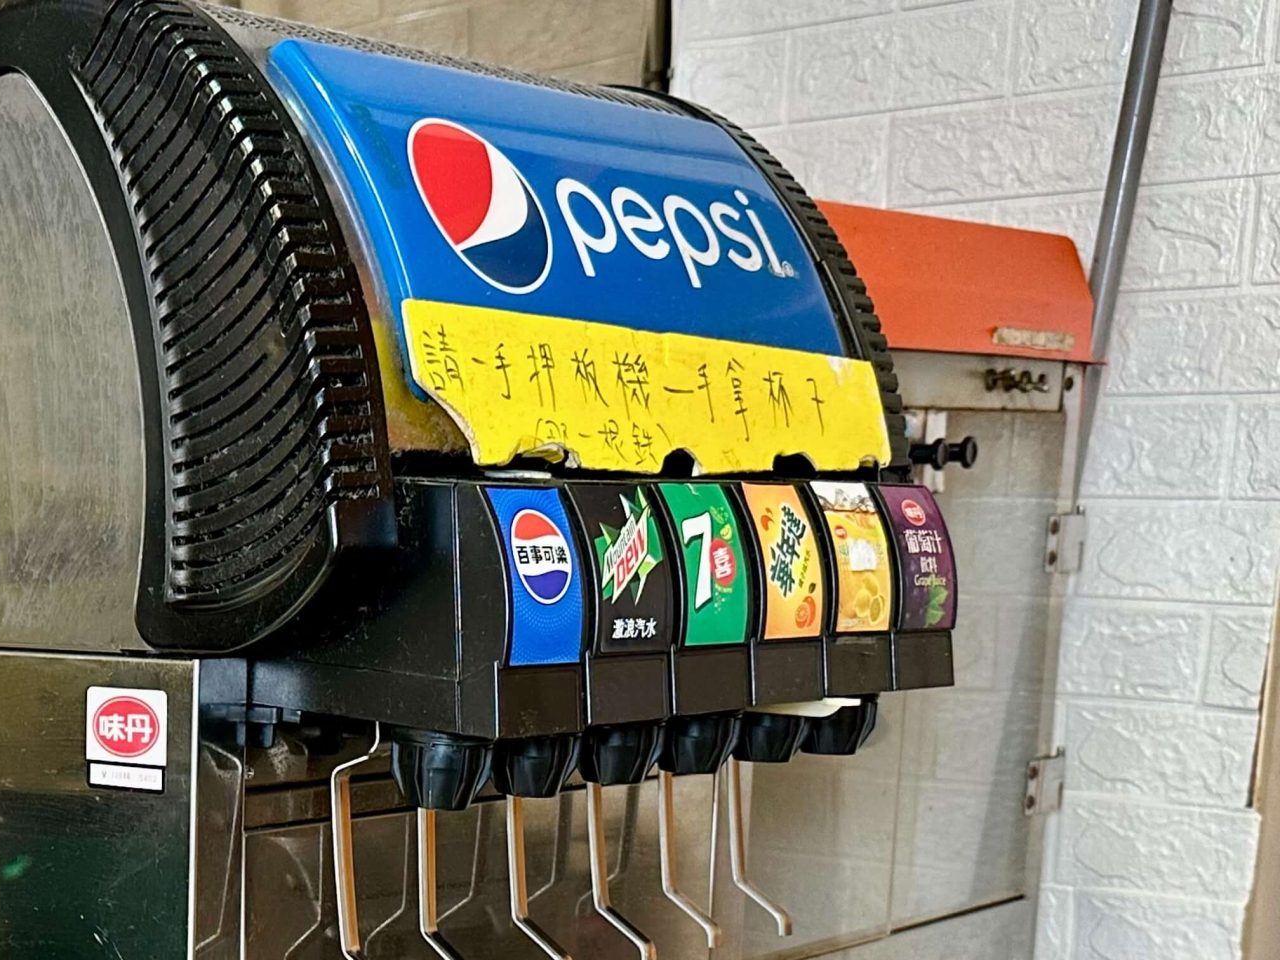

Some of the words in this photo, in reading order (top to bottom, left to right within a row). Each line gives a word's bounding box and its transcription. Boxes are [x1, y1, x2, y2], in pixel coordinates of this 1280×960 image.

[556, 177, 784, 288] pepsi
[515, 544, 569, 565] 百事可樂
[903, 528, 943, 554] 葡萄汁
[98, 713, 153, 743] 味丹
